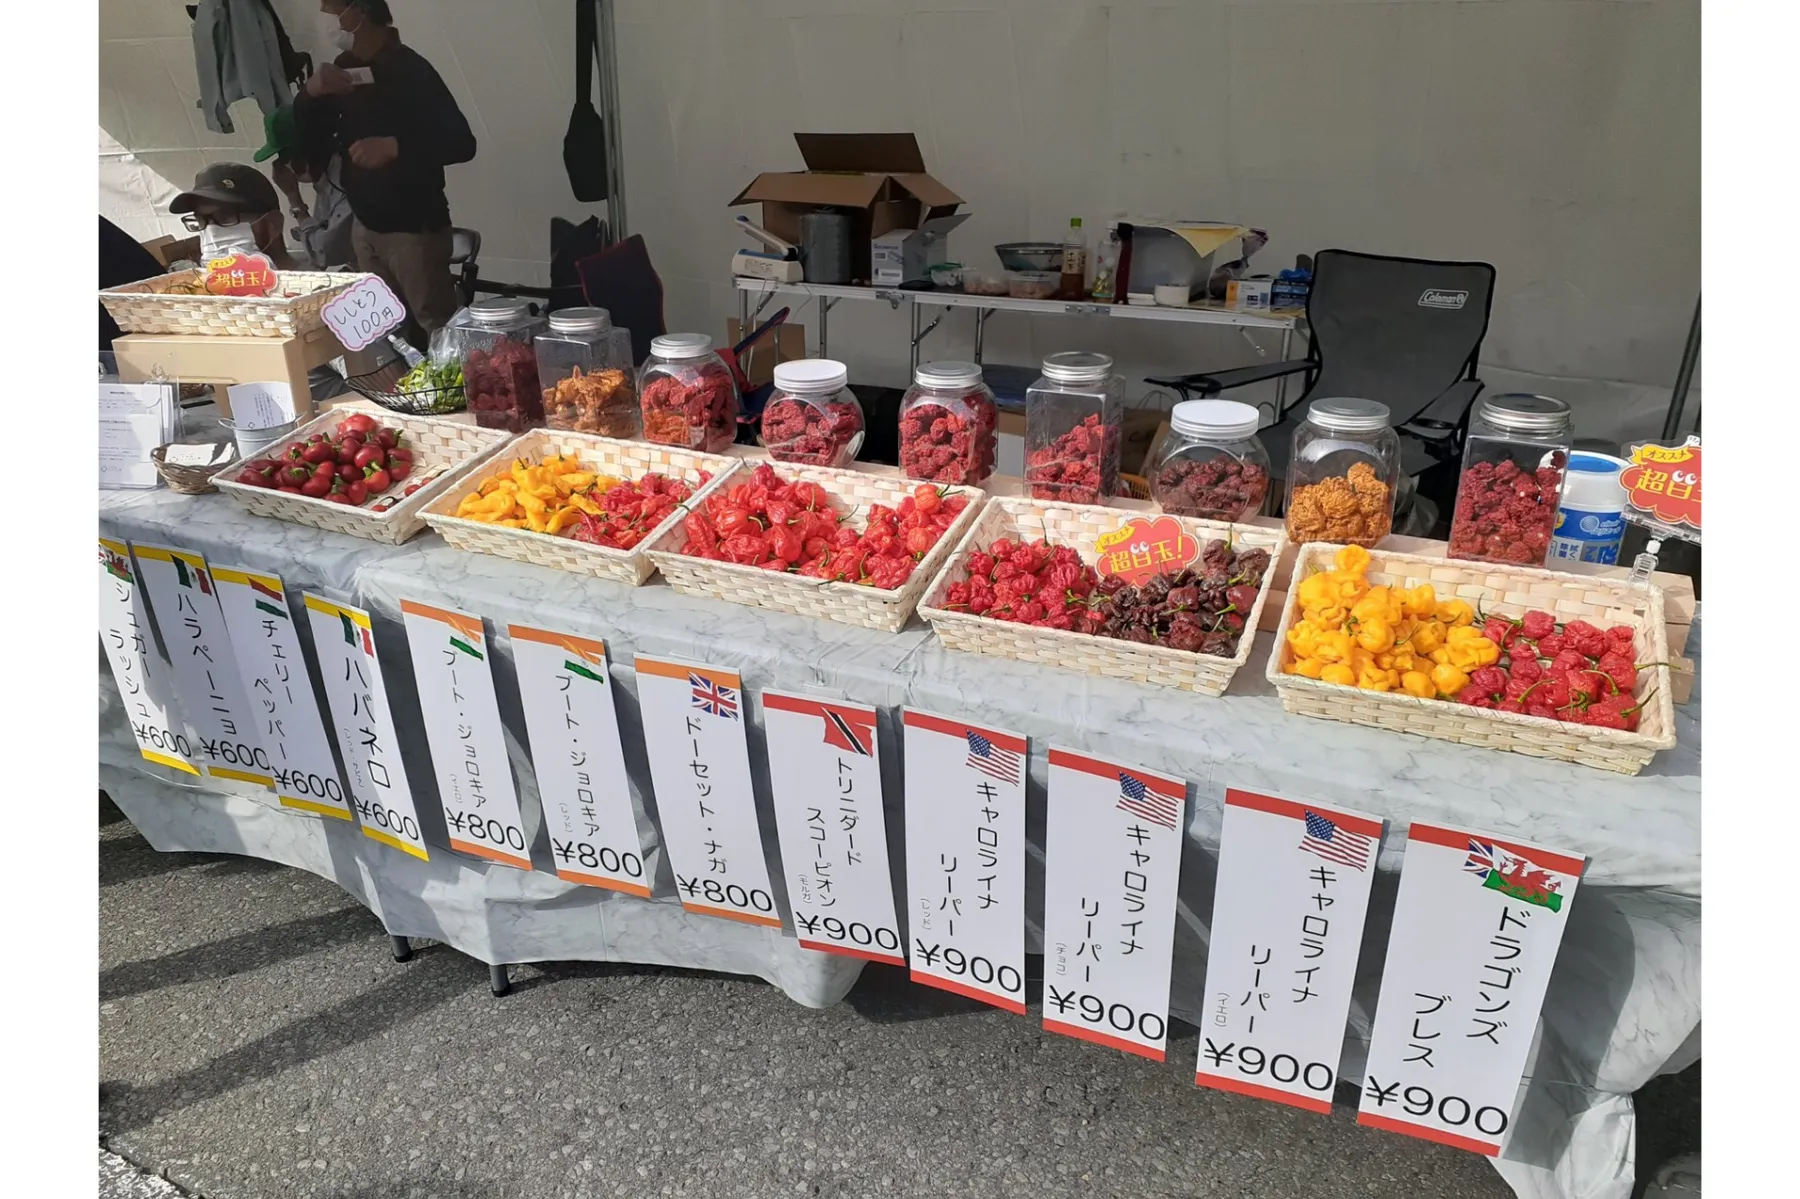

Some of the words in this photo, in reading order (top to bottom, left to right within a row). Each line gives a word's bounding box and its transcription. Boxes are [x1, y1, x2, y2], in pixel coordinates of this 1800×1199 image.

[333, 289, 377, 325] ししとう
[353, 306, 394, 340] 100円
[1424, 291, 1458, 304] Coleman
[116, 582, 151, 678] シュガー
[177, 593, 237, 735] ハラペーニョ
[262, 620, 293, 705] チェリー
[109, 628, 151, 718] ラッシュ
[132, 720, 192, 758] ¥600
[199, 736, 271, 771] ¥600
[254, 677, 286, 760] ペッパー
[345, 657, 391, 789] ハバネロ
[443, 650, 487, 808] ブート・ジョロキア
[556, 674, 600, 837] ブート・ジョロキア
[271, 765, 343, 802] ¥600
[355, 796, 419, 842] ¥600
[686, 715, 727, 874] ドーセット・ナガ
[838, 757, 862, 866] トリニダード
[445, 806, 525, 852] ¥800
[552, 837, 642, 878] ¥800
[806, 806, 836, 907] スコーピオン
[975, 781, 999, 910] キャロライナ
[675, 873, 774, 912] ¥800
[798, 874, 813, 904] (モルガ)
[938, 853, 962, 937] リーパー
[1119, 824, 1151, 956] キャロライナ
[796, 911, 899, 951] ¥900
[915, 937, 1022, 993] ¥900
[1075, 896, 1103, 982] リーパー
[1291, 866, 1338, 1004] キャロライナ
[1048, 984, 1166, 1041] ¥900
[1214, 992, 1231, 1028] (イエロ)
[1240, 944, 1272, 1034] リーパー
[1466, 906, 1531, 1045] ドラゴンズ
[1203, 1037, 1334, 1093] ¥900
[1402, 992, 1452, 1069] ブレス
[1365, 1074, 1509, 1137] ¥900
